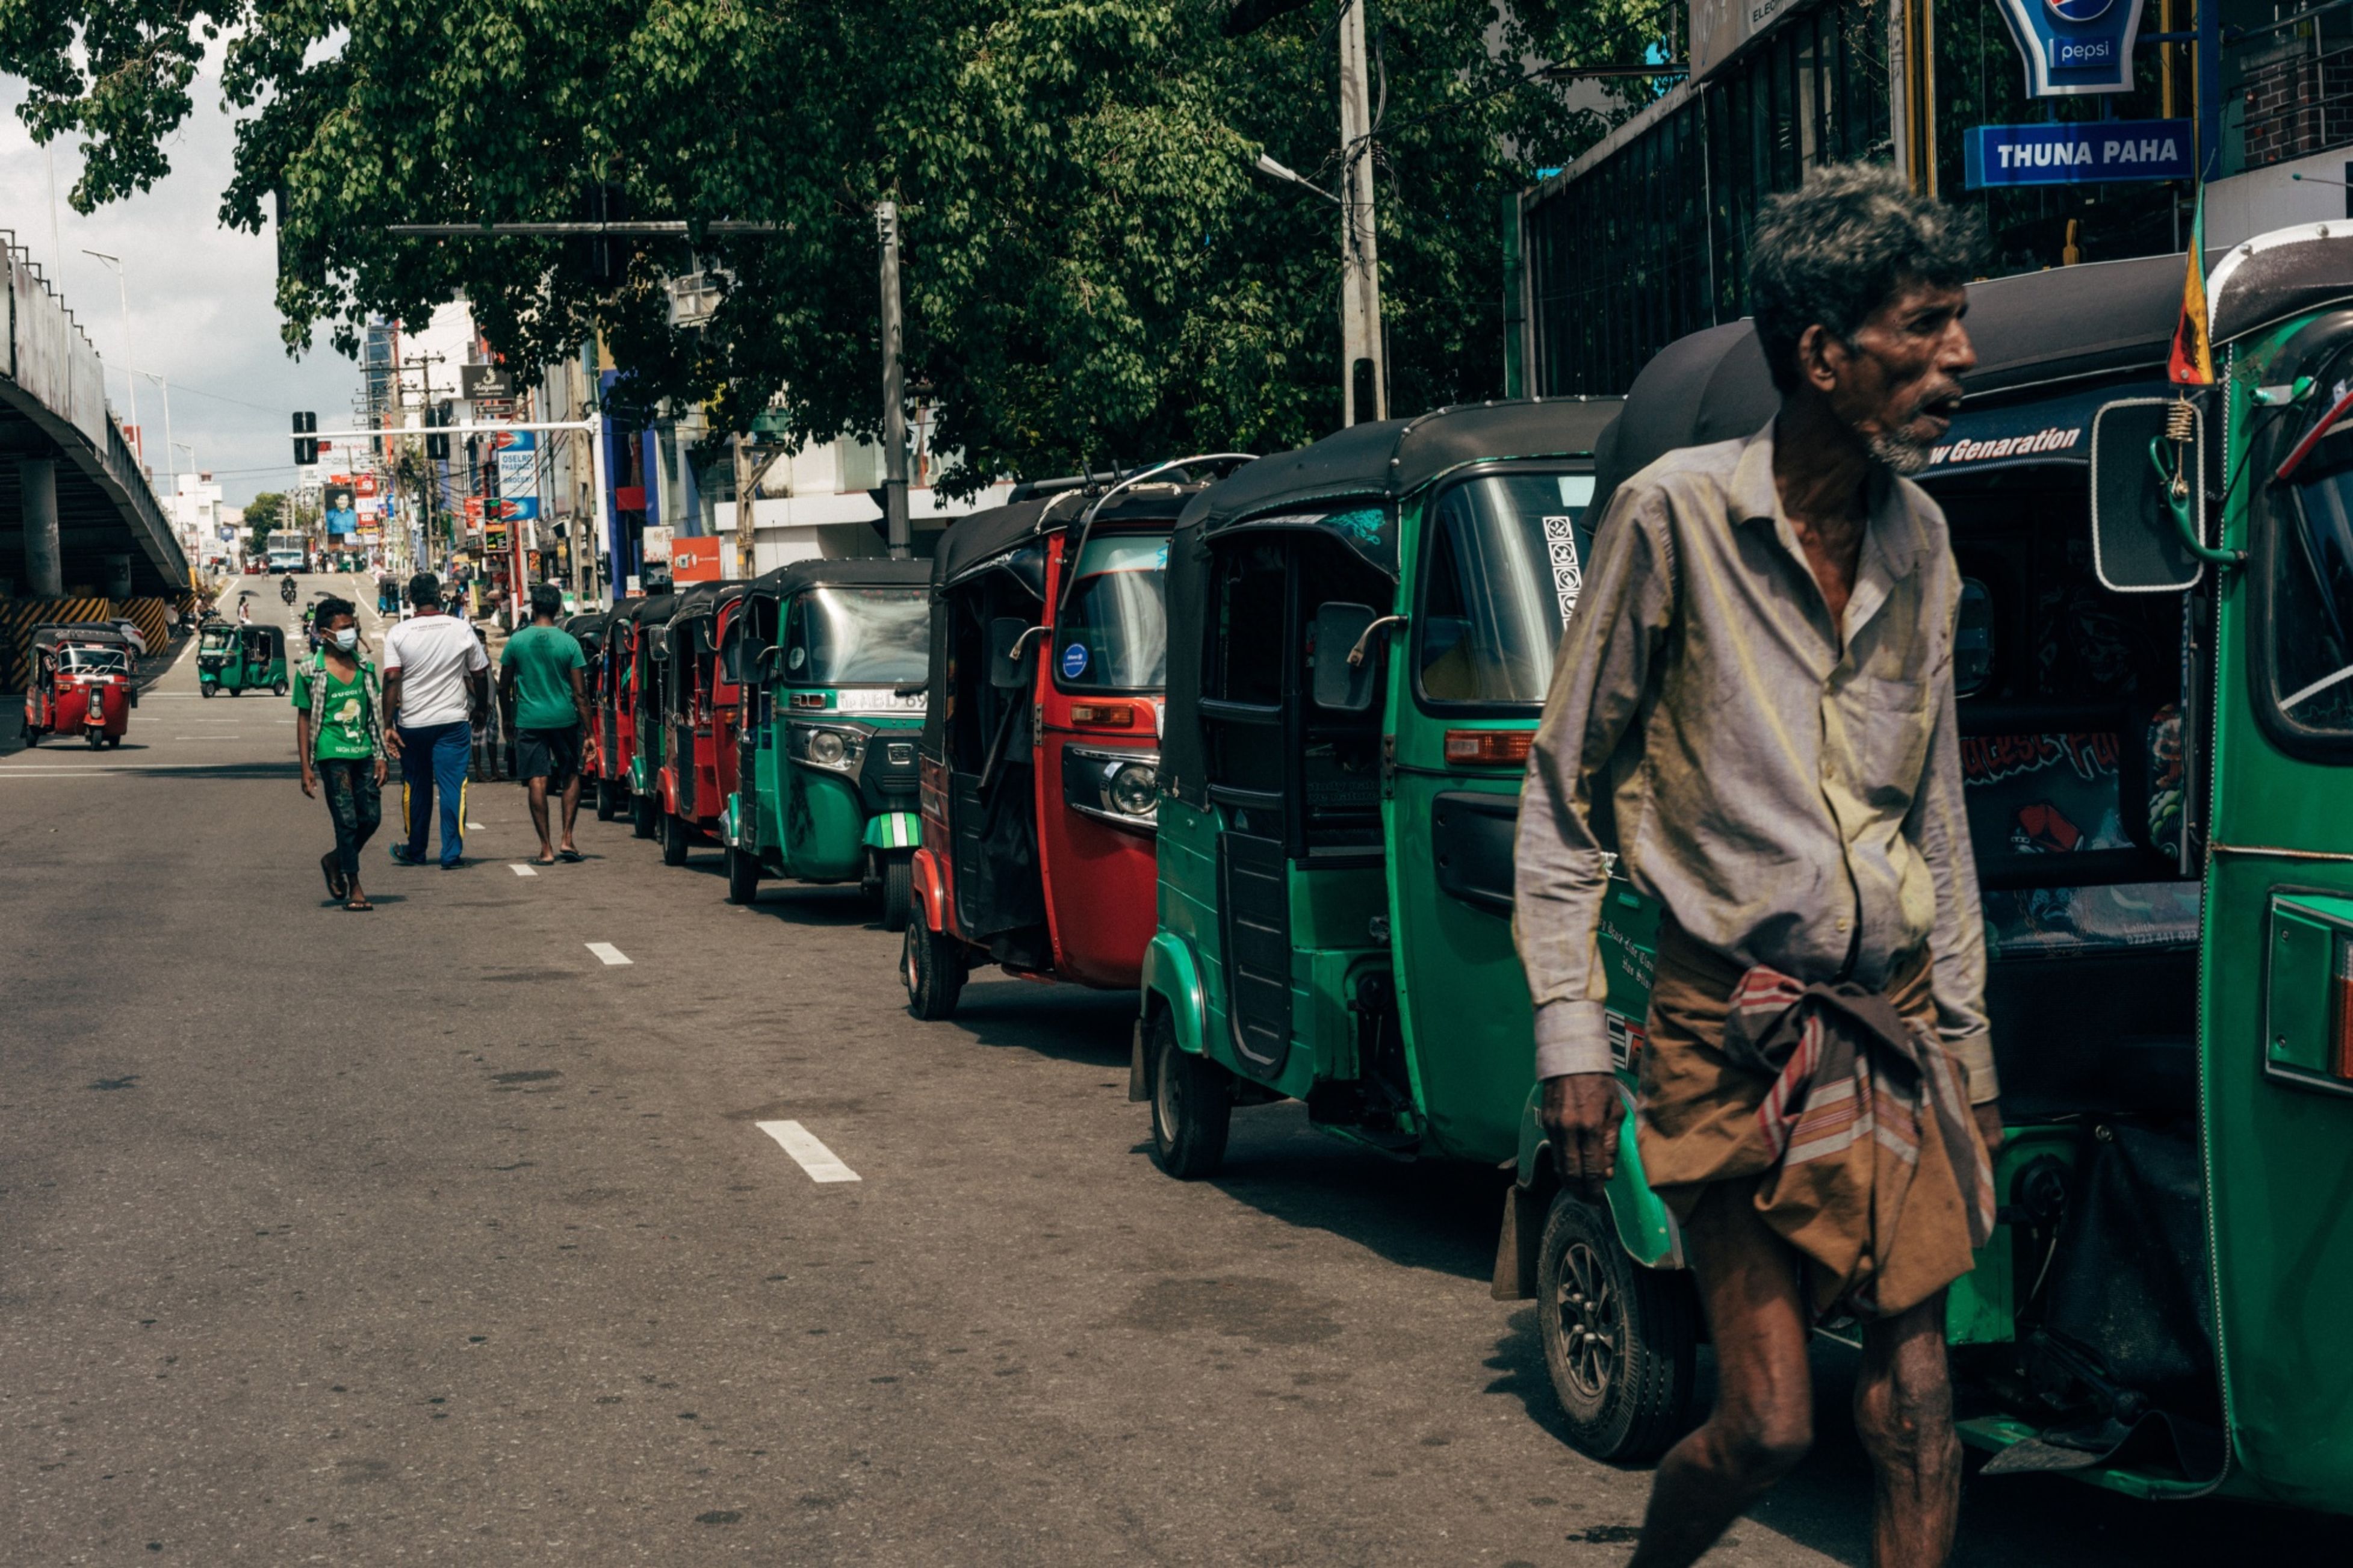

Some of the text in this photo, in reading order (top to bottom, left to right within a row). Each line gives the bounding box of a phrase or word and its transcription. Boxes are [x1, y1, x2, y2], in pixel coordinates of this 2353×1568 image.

[2062, 41, 2109, 62] pepsi
[1997, 138, 2178, 169] THUNA PAHA
[1948, 427, 2081, 463] Genaration
[331, 689, 358, 698] GUCCI
